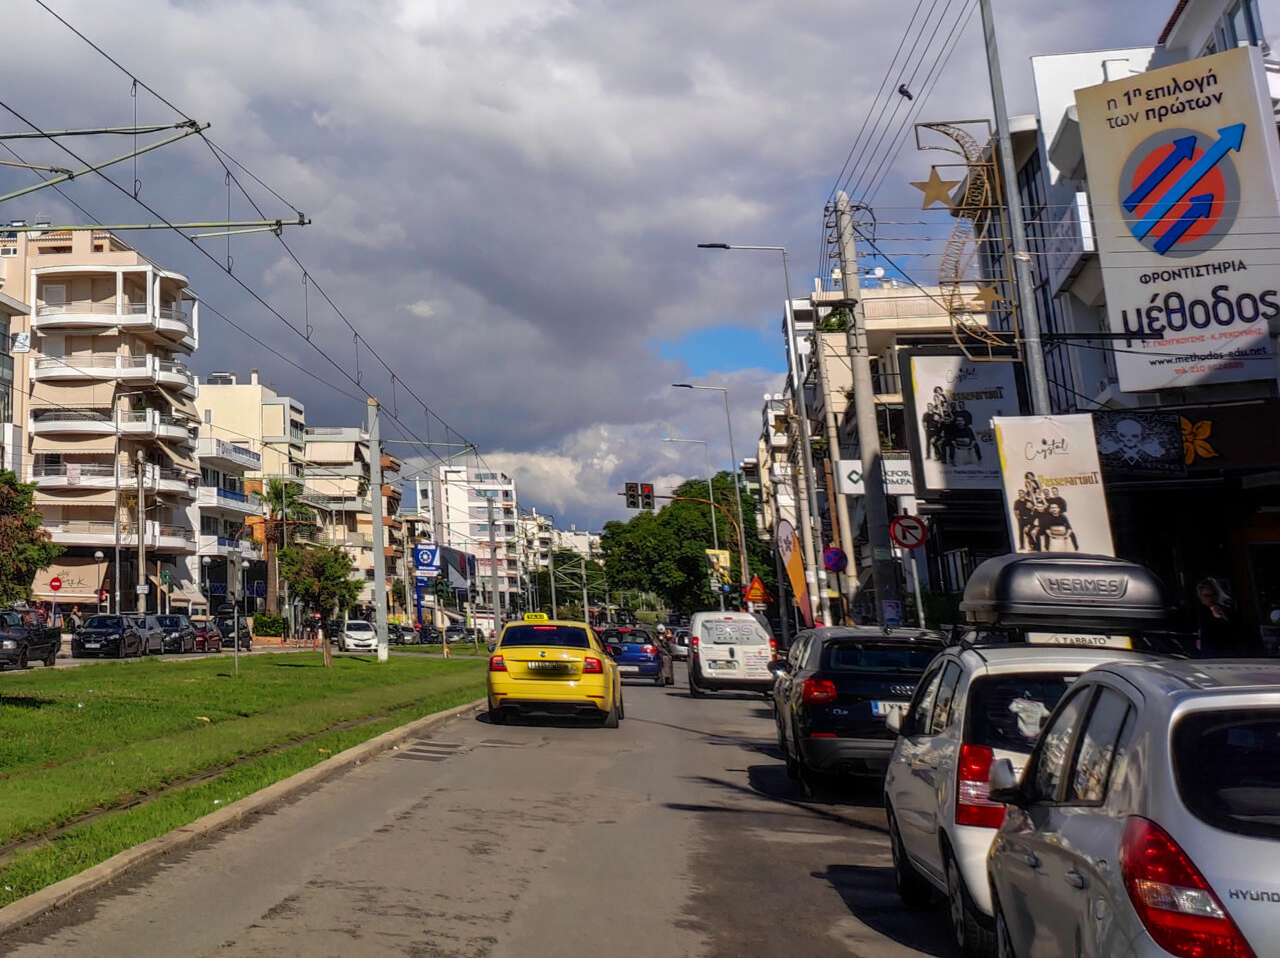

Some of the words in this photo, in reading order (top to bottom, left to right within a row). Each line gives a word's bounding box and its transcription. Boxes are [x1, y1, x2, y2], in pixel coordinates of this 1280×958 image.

[1145, 68, 1218, 102] επιλογή
[1106, 111, 1140, 129] των
[1145, 92, 1223, 123] πρώτων
[1139, 259, 1247, 284] ΦΡΟΝΤΙΣΤΗΡΙΑ
[1122, 284, 1280, 348] μέθοδος
[1048, 578, 1119, 594] HERMES
